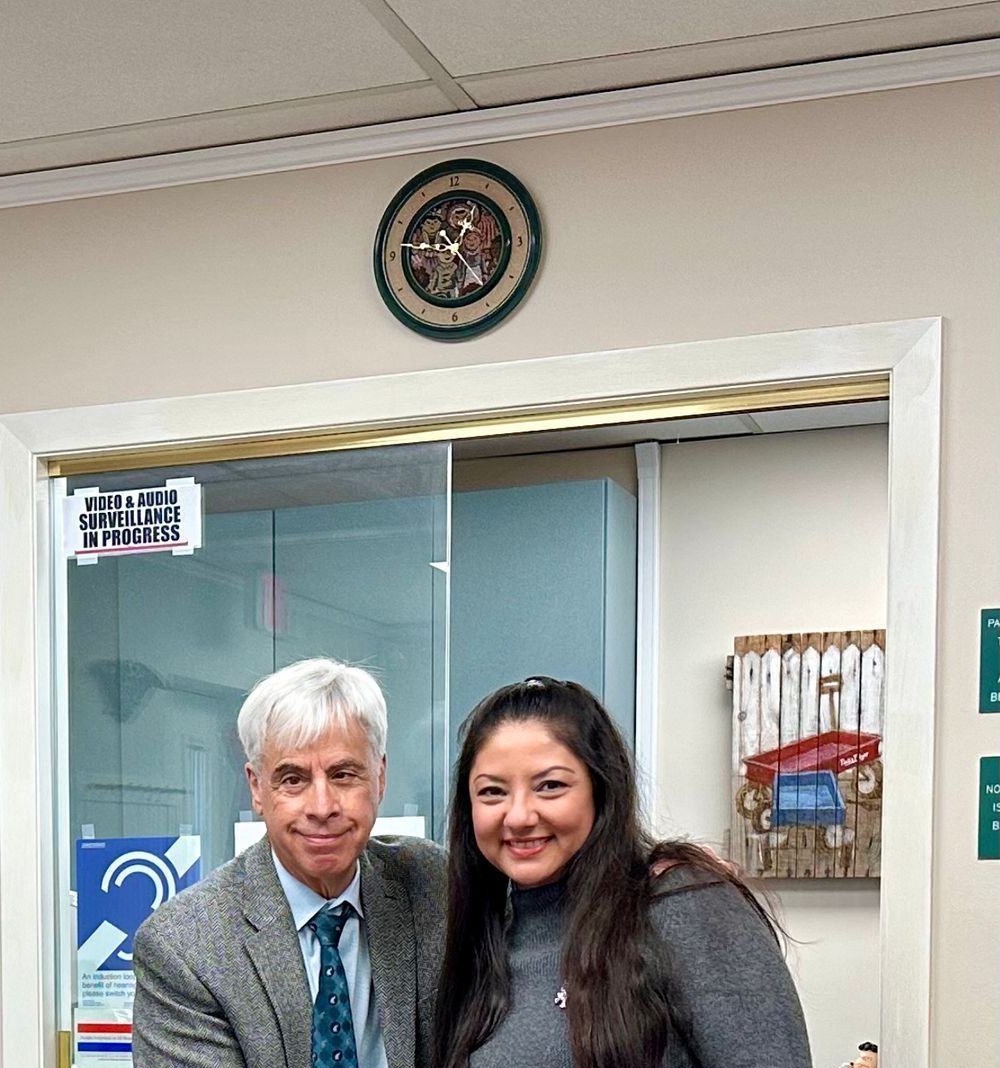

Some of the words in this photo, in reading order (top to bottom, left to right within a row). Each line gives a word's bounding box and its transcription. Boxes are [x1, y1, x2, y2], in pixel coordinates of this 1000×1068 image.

[449, 176, 460, 187] 12
[517, 237, 523, 247] 3
[389, 251, 396, 262] 9
[451, 312, 458, 322] 6
[84, 494, 122, 512] VIDEO
[125, 495, 135, 509] &
[138, 489, 178, 507] AUDIO
[79, 506, 181, 531] SURVEILLANCE
[83, 531, 99, 549] IN
[102, 525, 180, 547] PROGRESS
[106, 981, 113, 989] of
[82, 991, 104, 999] please
[105, 990, 126, 998] switch
